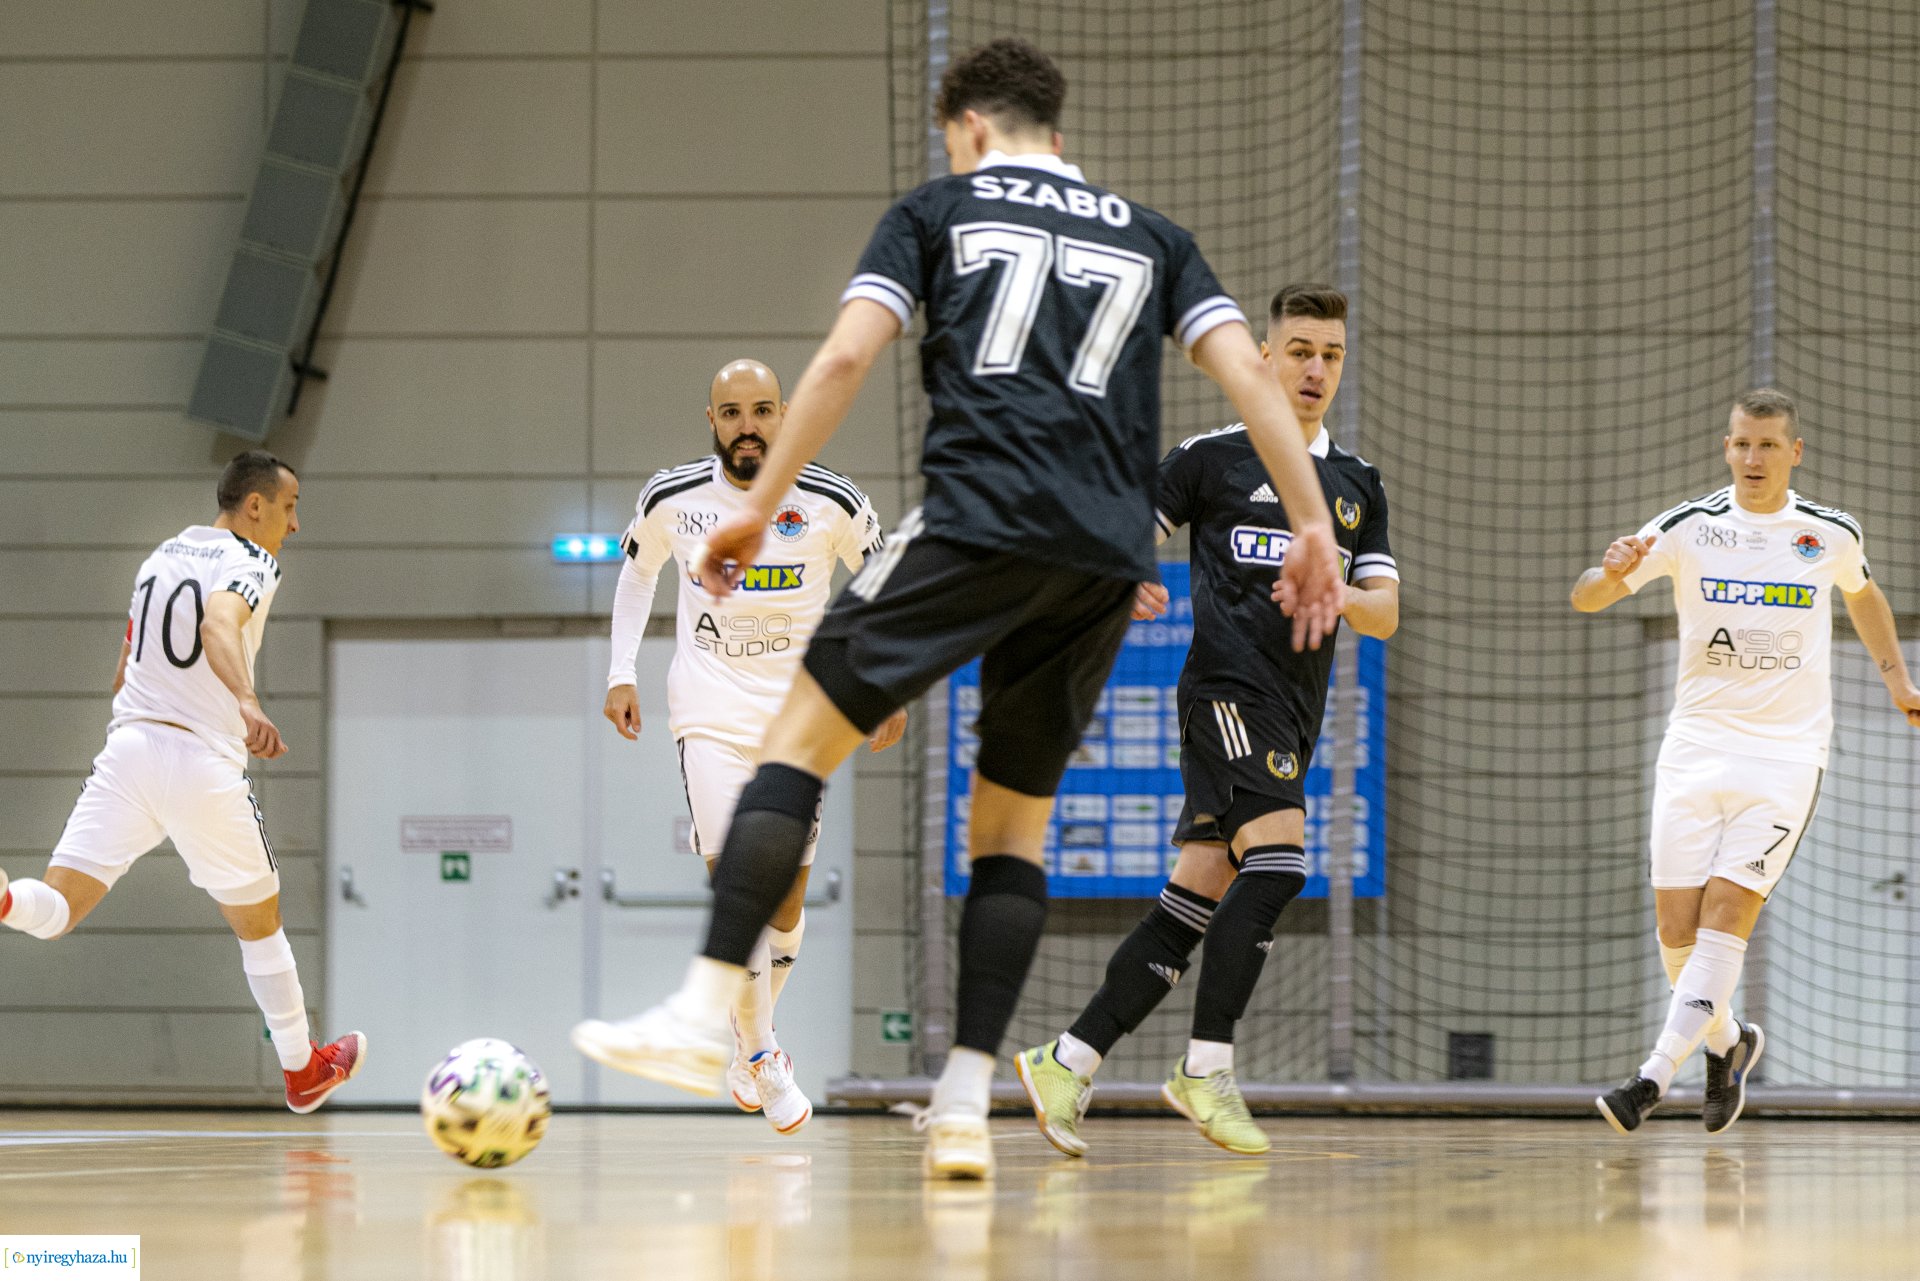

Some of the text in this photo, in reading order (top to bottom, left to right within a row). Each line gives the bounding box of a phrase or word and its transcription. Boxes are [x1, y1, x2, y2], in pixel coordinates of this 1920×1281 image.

[951, 221, 1154, 398] 77
[1250, 493, 1279, 504] adidas
[1696, 524, 1738, 549] 383
[135, 575, 205, 669] 10
[694, 635, 790, 657] STUDIO
[1706, 651, 1802, 670] STUDIO
[1763, 824, 1790, 856] 7
